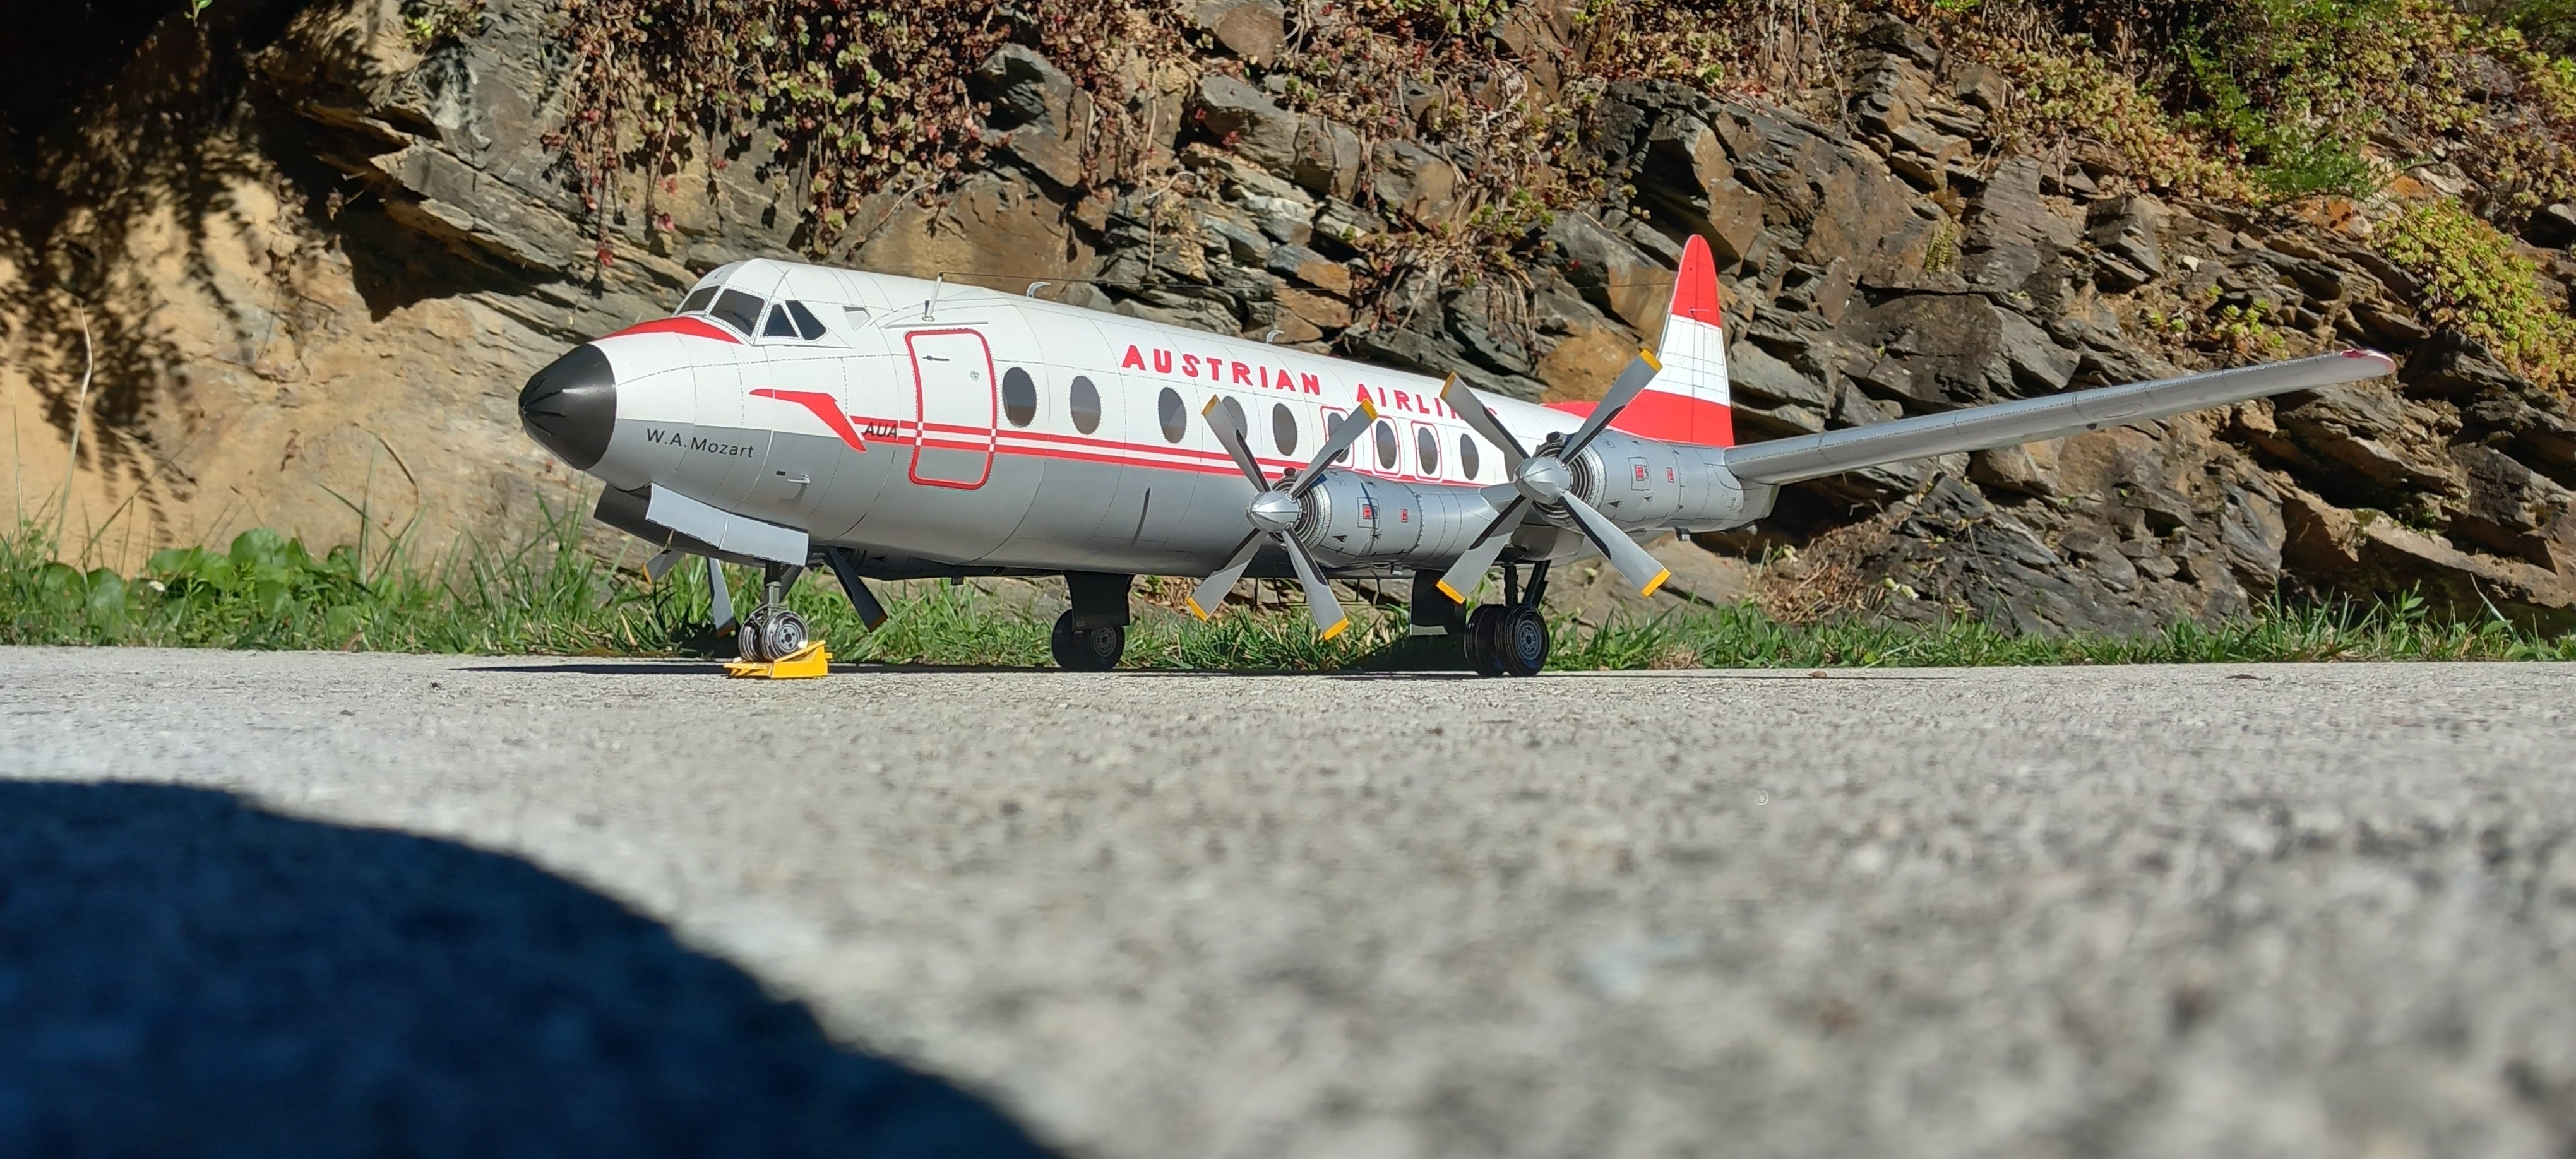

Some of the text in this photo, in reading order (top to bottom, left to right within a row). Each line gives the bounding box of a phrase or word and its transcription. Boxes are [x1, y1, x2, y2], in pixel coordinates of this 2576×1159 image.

[1121, 344, 1497, 420] AUSTRIAN AIRLI
[861, 422, 897, 438] AUA
